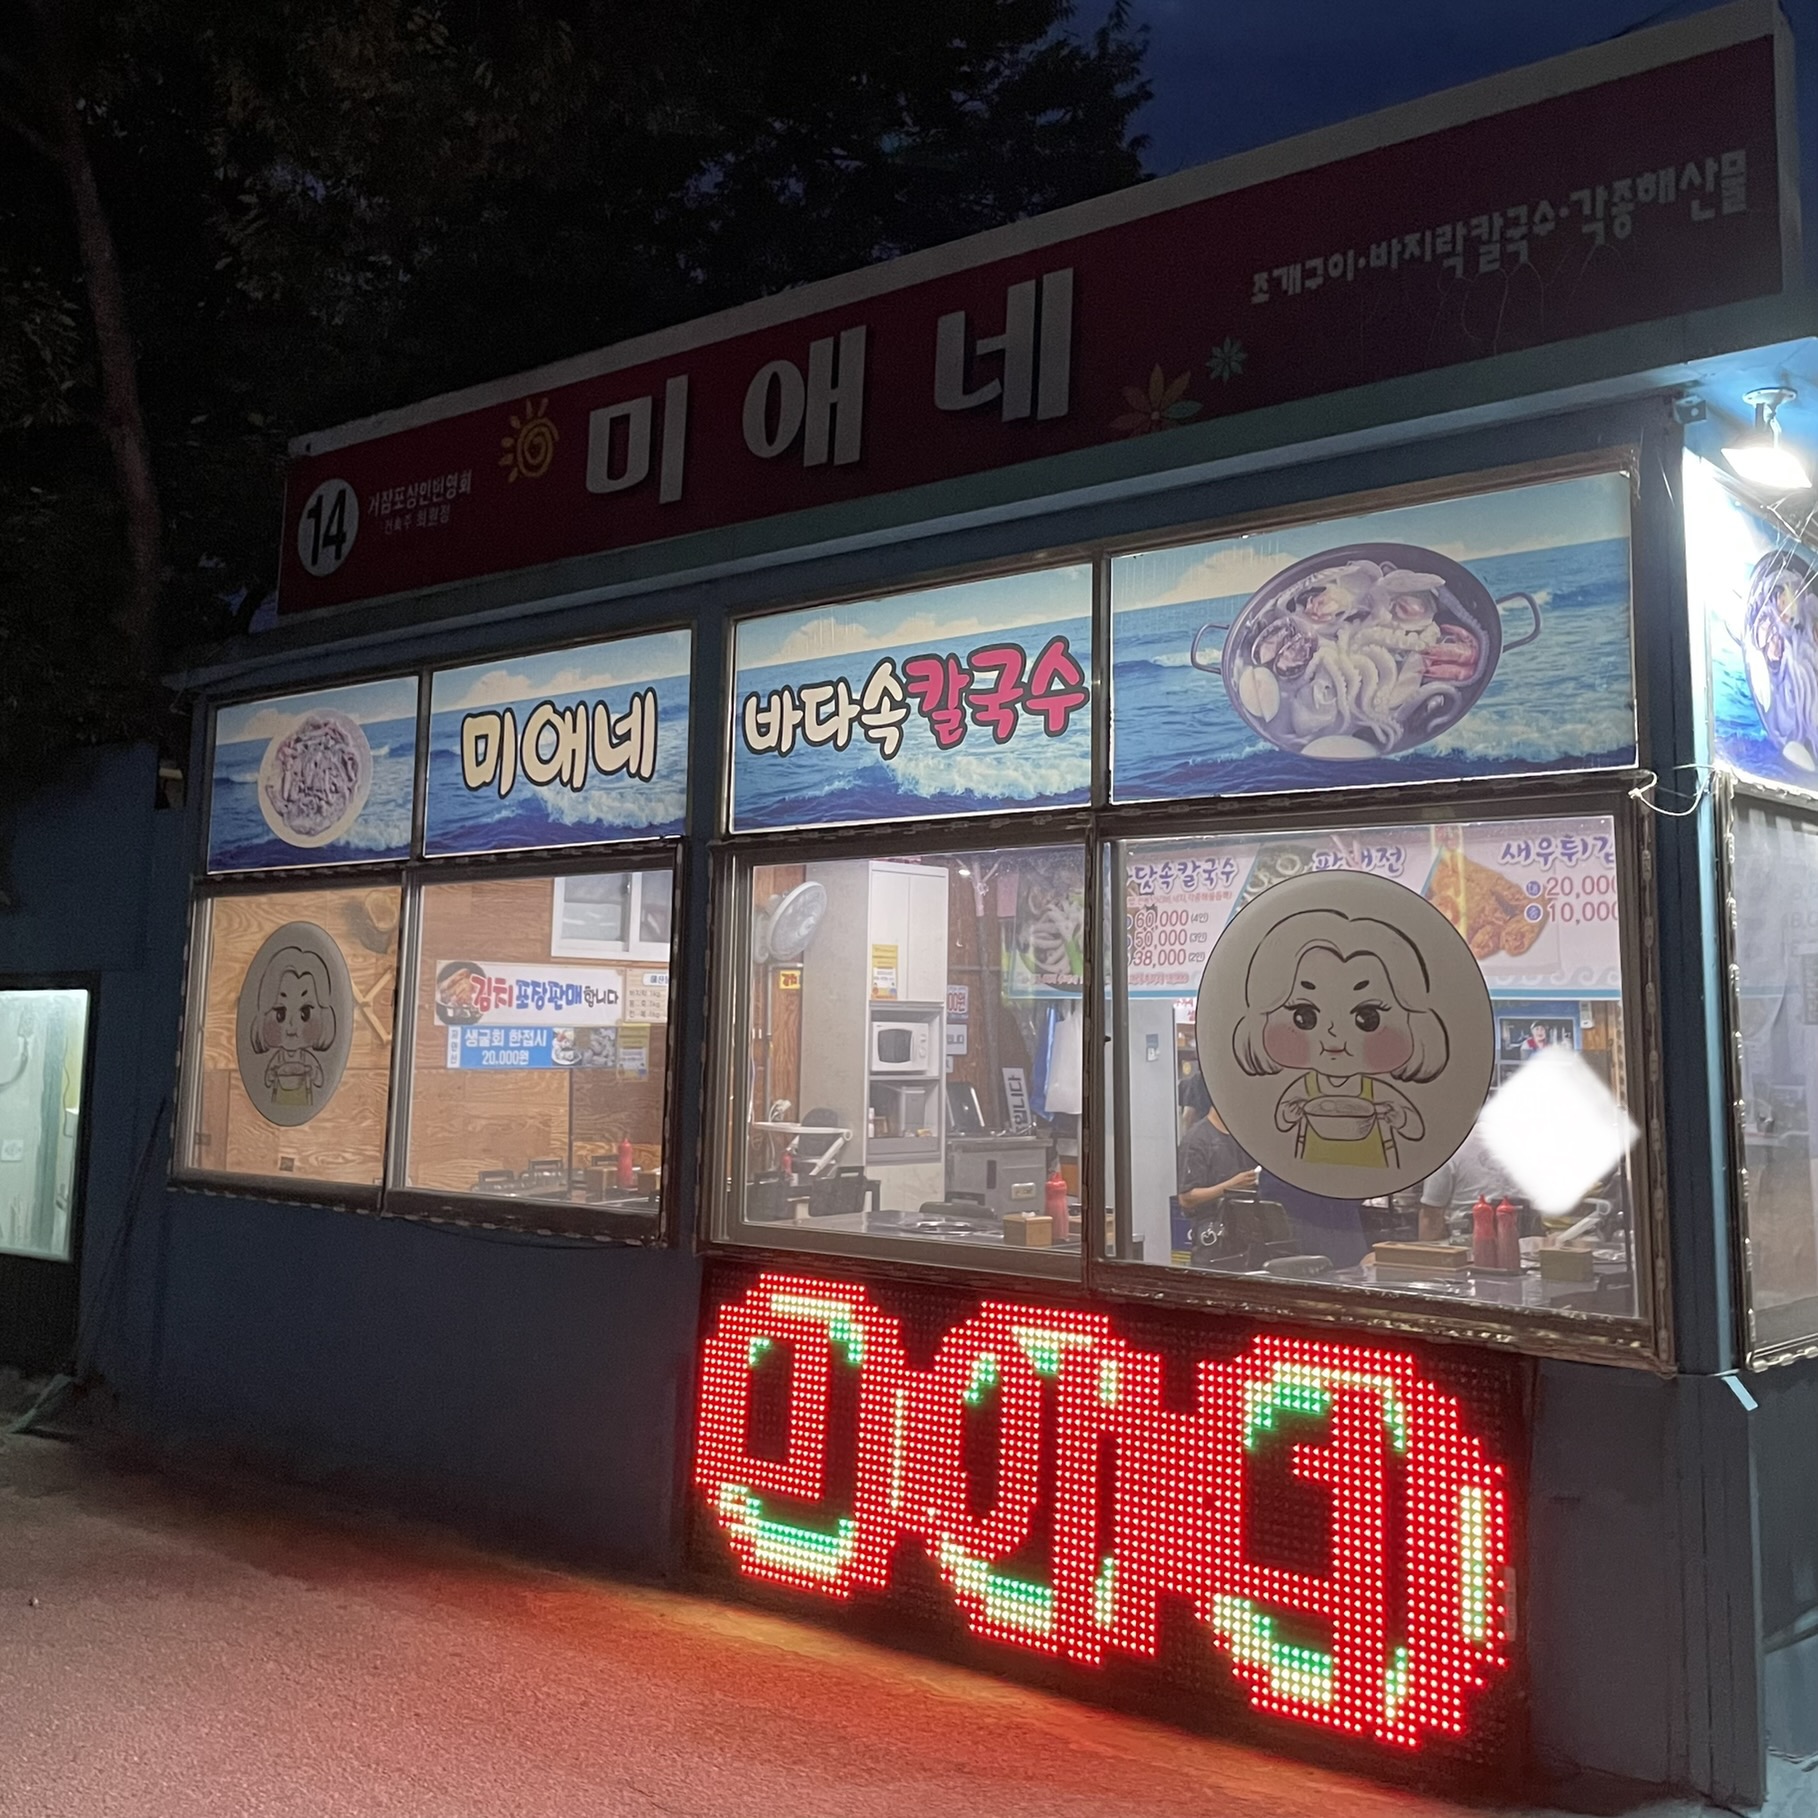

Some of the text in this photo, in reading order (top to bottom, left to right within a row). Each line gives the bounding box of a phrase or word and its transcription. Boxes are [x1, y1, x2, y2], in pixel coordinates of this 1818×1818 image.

[305, 488, 348, 566] 14
[461, 687, 660, 798] 미애네
[1135, 910, 1189, 929] 60,000
[1134, 929, 1188, 949] 50,000
[1133, 949, 1187, 968] 38,000
[470, 974, 513, 1013] 김치
[465, 1028, 547, 1047] 생굴회 한접시
